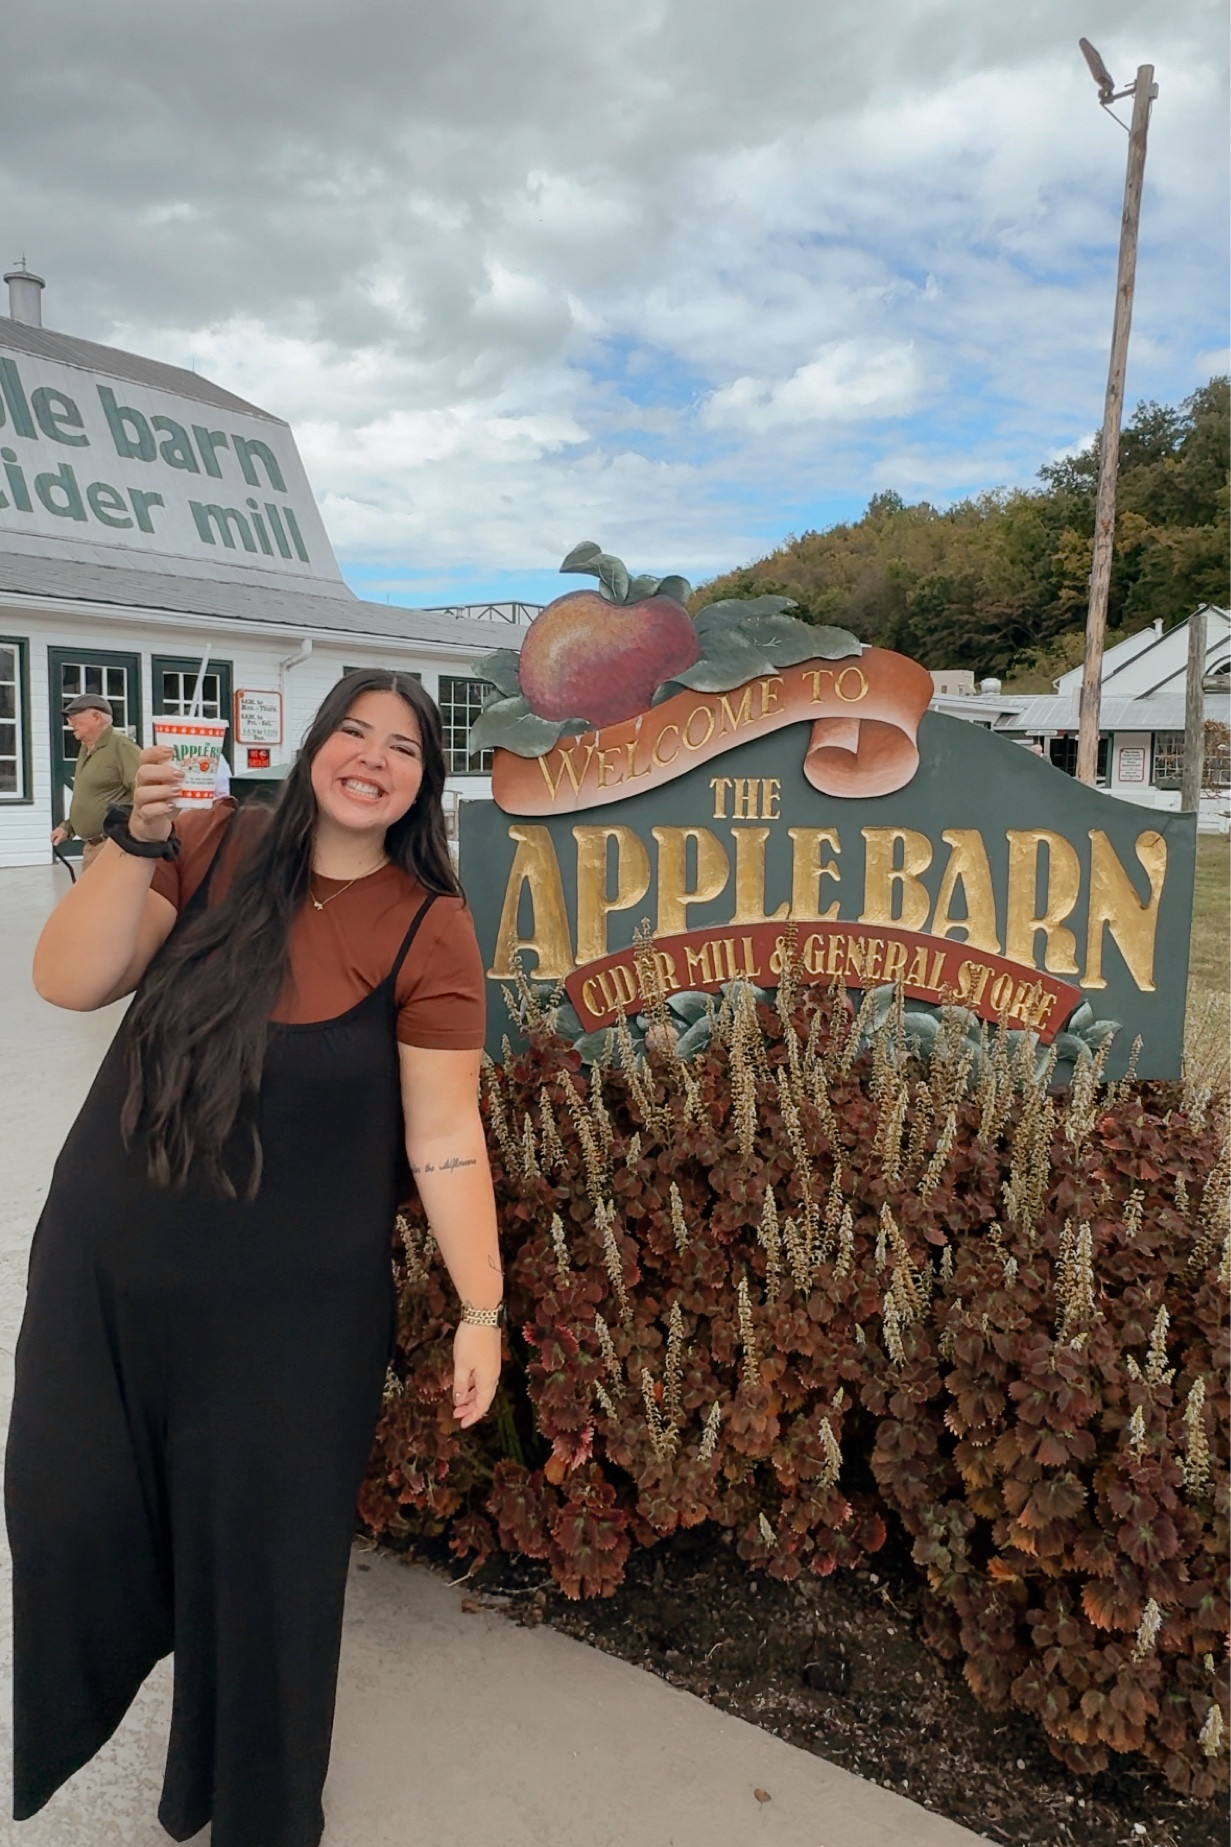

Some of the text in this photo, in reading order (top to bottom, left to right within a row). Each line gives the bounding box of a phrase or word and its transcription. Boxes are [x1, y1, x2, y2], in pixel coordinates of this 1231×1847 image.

[0, 356, 288, 493] le barn
[188, 497, 310, 563] mill
[537, 666, 870, 801] WELCOME TO
[709, 777, 782, 820] THE
[487, 824, 1168, 992] APPLE BARN
[582, 952, 682, 1017] CIDER
[684, 936, 761, 987] MILL
[803, 933, 947, 992] GENERAL
[953, 960, 1058, 1031] STORE
